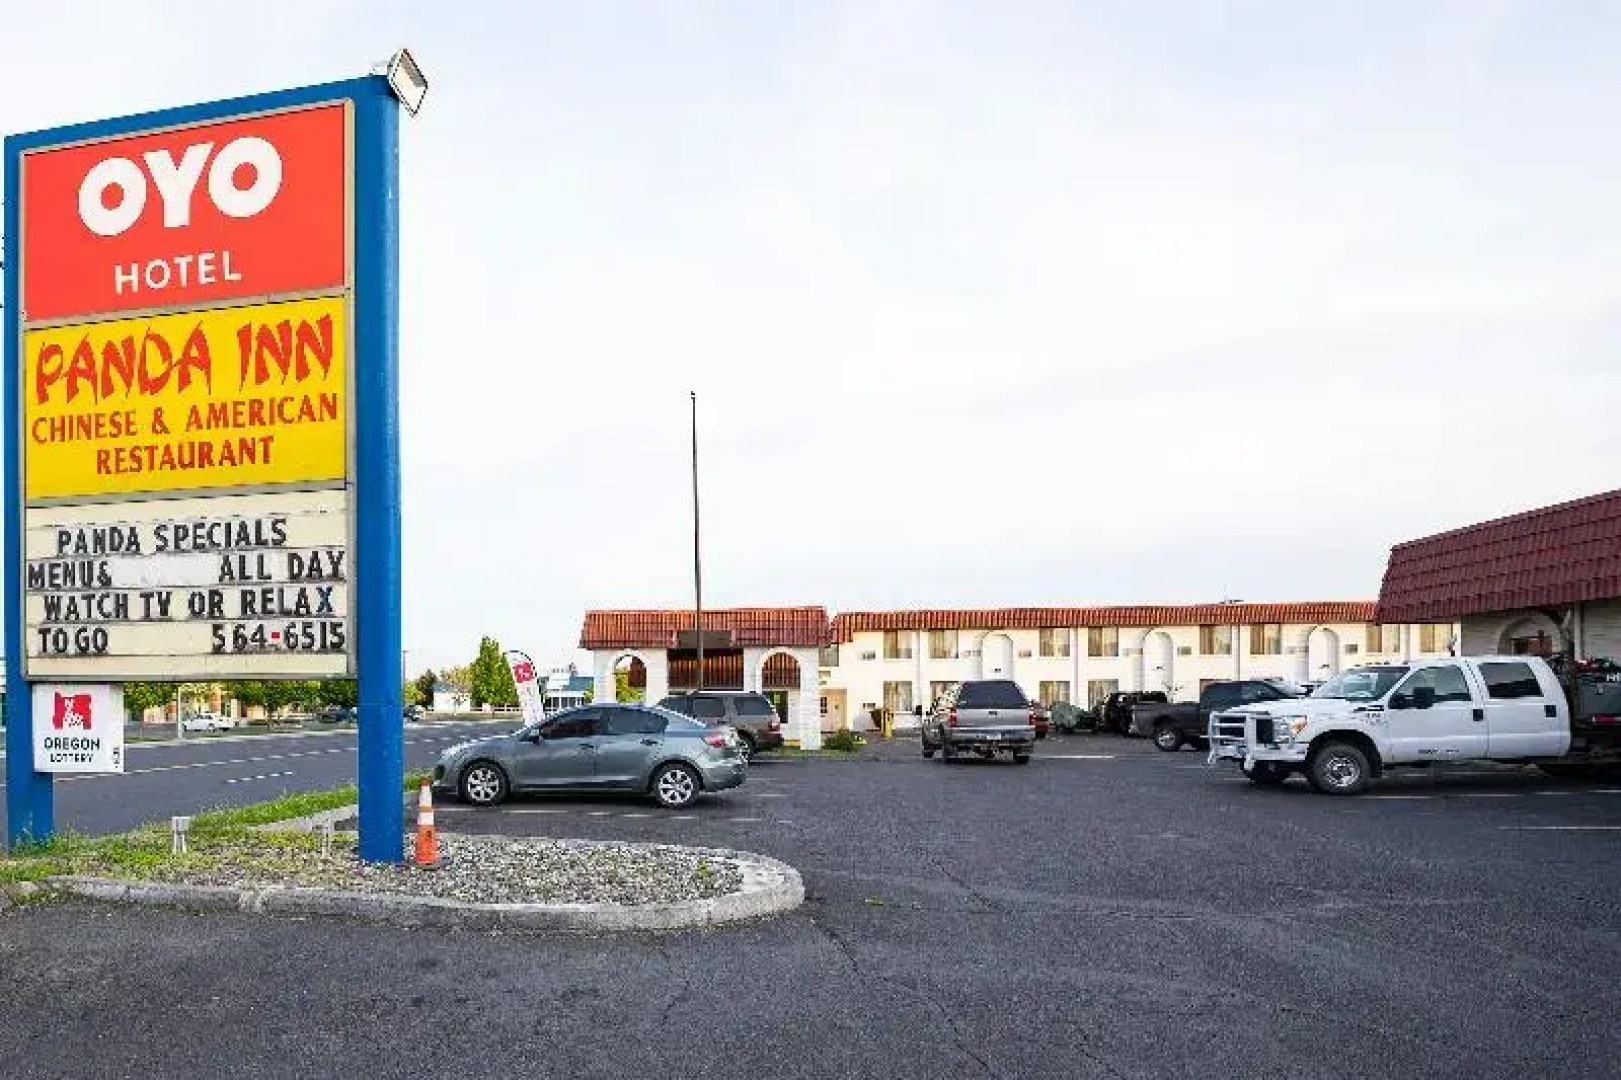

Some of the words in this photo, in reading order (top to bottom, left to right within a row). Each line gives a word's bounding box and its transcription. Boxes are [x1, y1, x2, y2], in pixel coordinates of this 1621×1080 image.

[78, 136, 283, 236] OYO
[114, 250, 242, 294] HOTEL
[36, 321, 211, 405] PANDA
[237, 314, 333, 393] INN
[32, 410, 138, 444] CHINESE
[152, 407, 170, 435] &
[186, 393, 337, 432] AMERICAN
[97, 436, 274, 474] RESTAURANT
[58, 527, 140, 553] PANDA
[154, 518, 287, 550] SPECIALS
[218, 553, 272, 582] ALL
[288, 551, 345, 580] DAY
[44, 593, 129, 620] WATCH
[140, 591, 173, 618] TV
[188, 589, 224, 618] OR
[240, 587, 333, 617] RELAX
[212, 622, 345, 651] 564-6515
[44, 737, 100, 750] OREGON
[50, 753, 93, 763] LOTTERY
